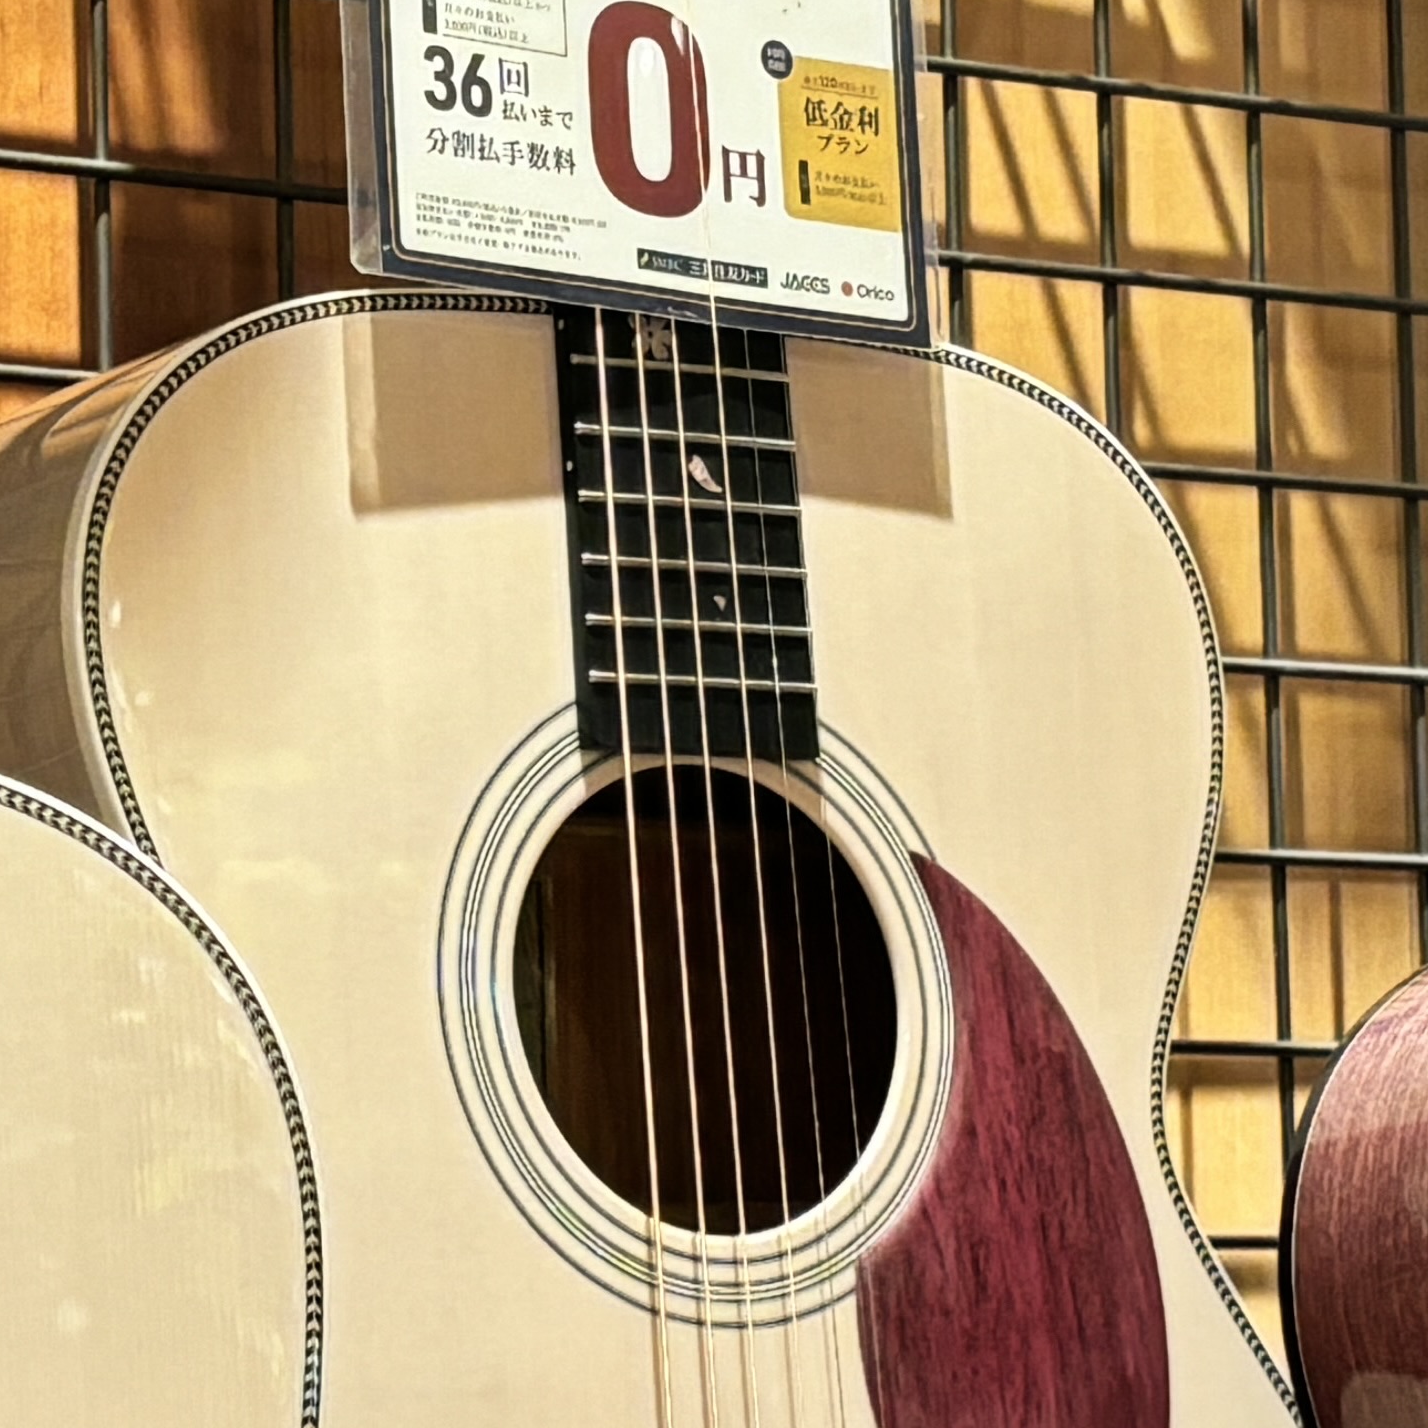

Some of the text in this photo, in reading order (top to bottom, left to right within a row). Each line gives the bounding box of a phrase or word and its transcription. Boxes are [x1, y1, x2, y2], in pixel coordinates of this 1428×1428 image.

[804, 97, 880, 136] 低金利
[426, 126, 577, 176] 分割払手数料
[817, 135, 869, 155] プラン
[781, 272, 895, 302] JACCS Orico
